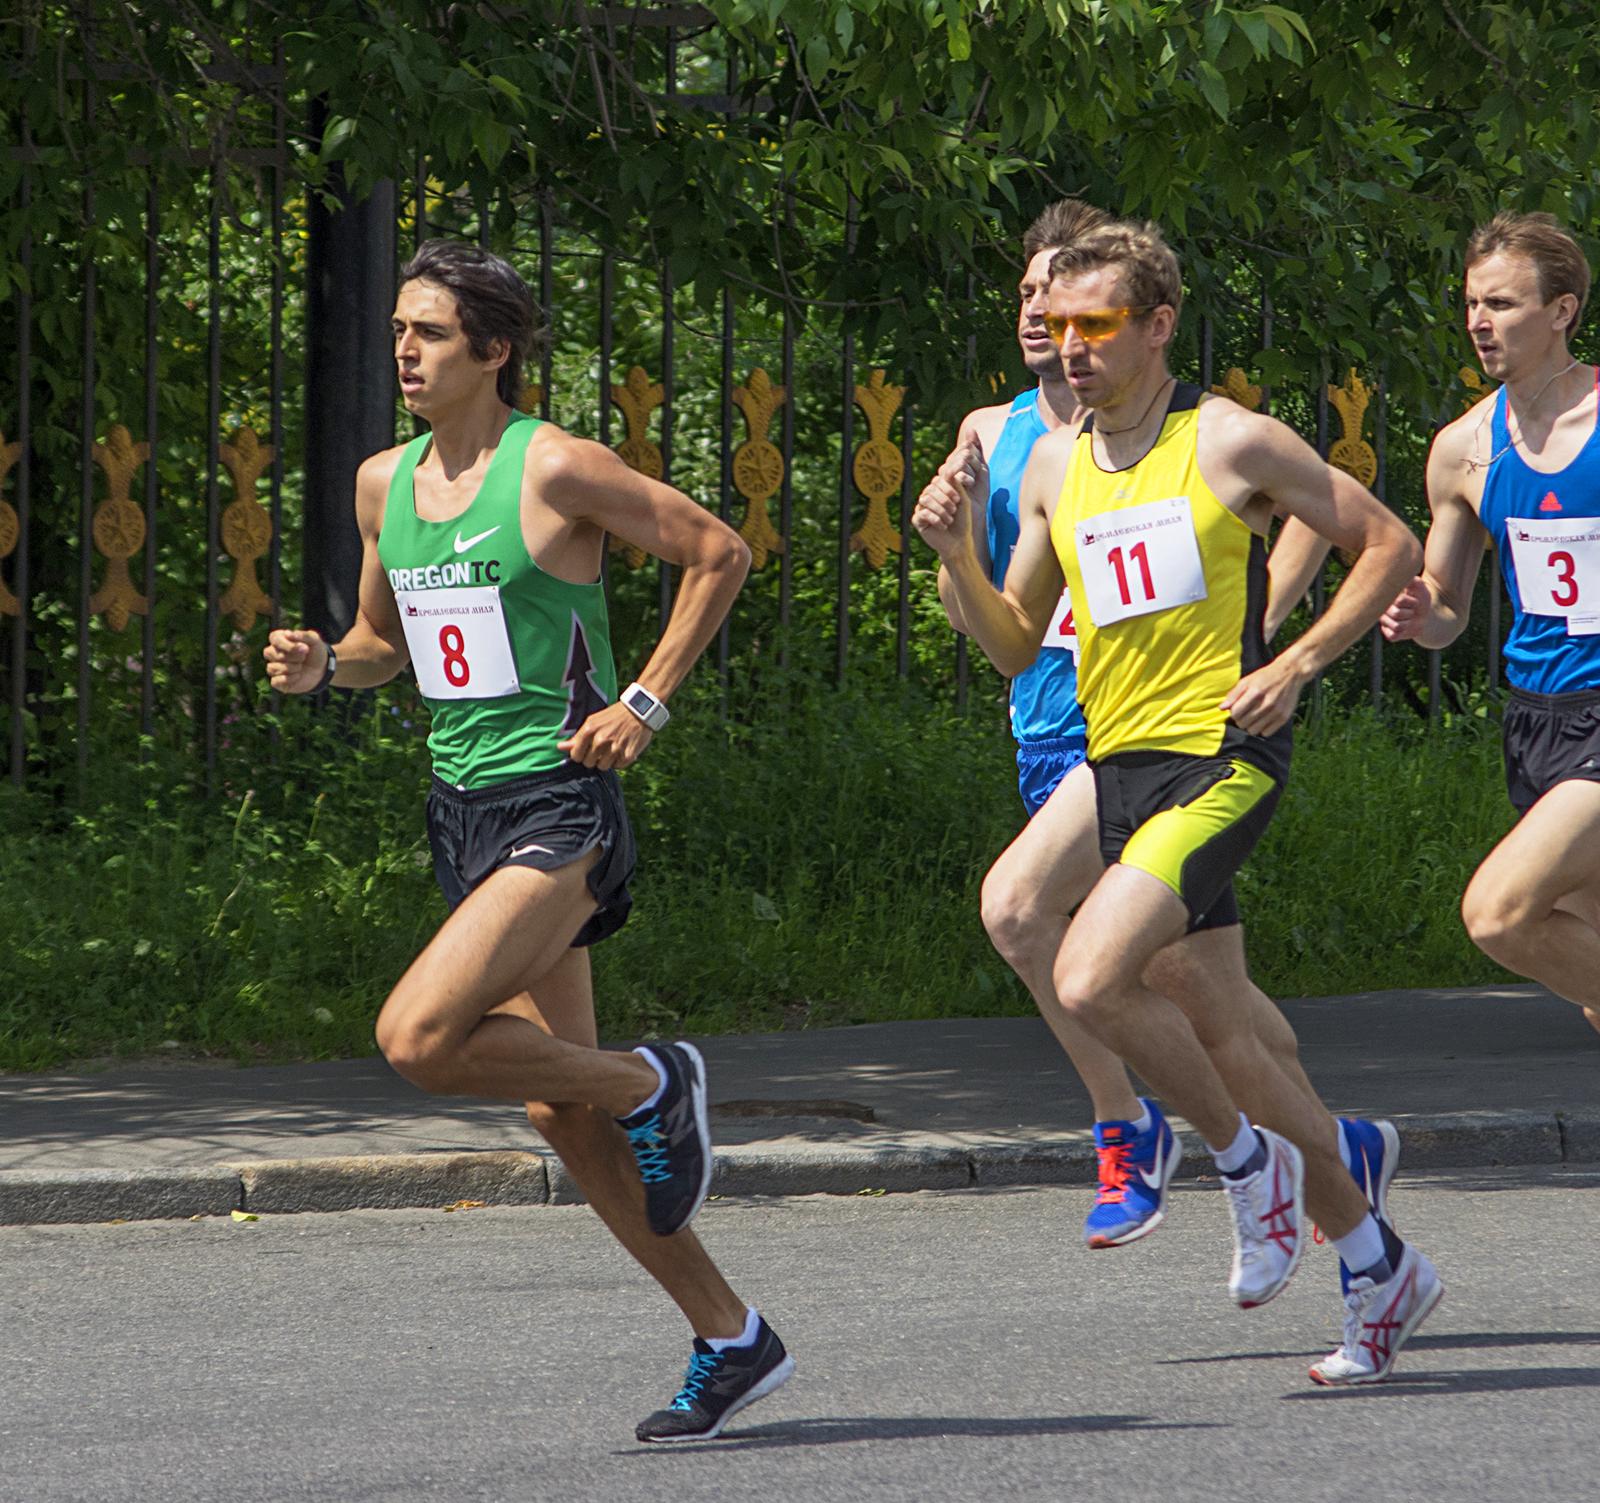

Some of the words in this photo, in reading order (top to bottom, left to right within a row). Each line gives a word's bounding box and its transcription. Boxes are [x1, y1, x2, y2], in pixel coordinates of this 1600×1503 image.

[1107, 541, 1156, 605] 11
[1547, 551, 1579, 607] 3
[438, 624, 470, 688] 8
